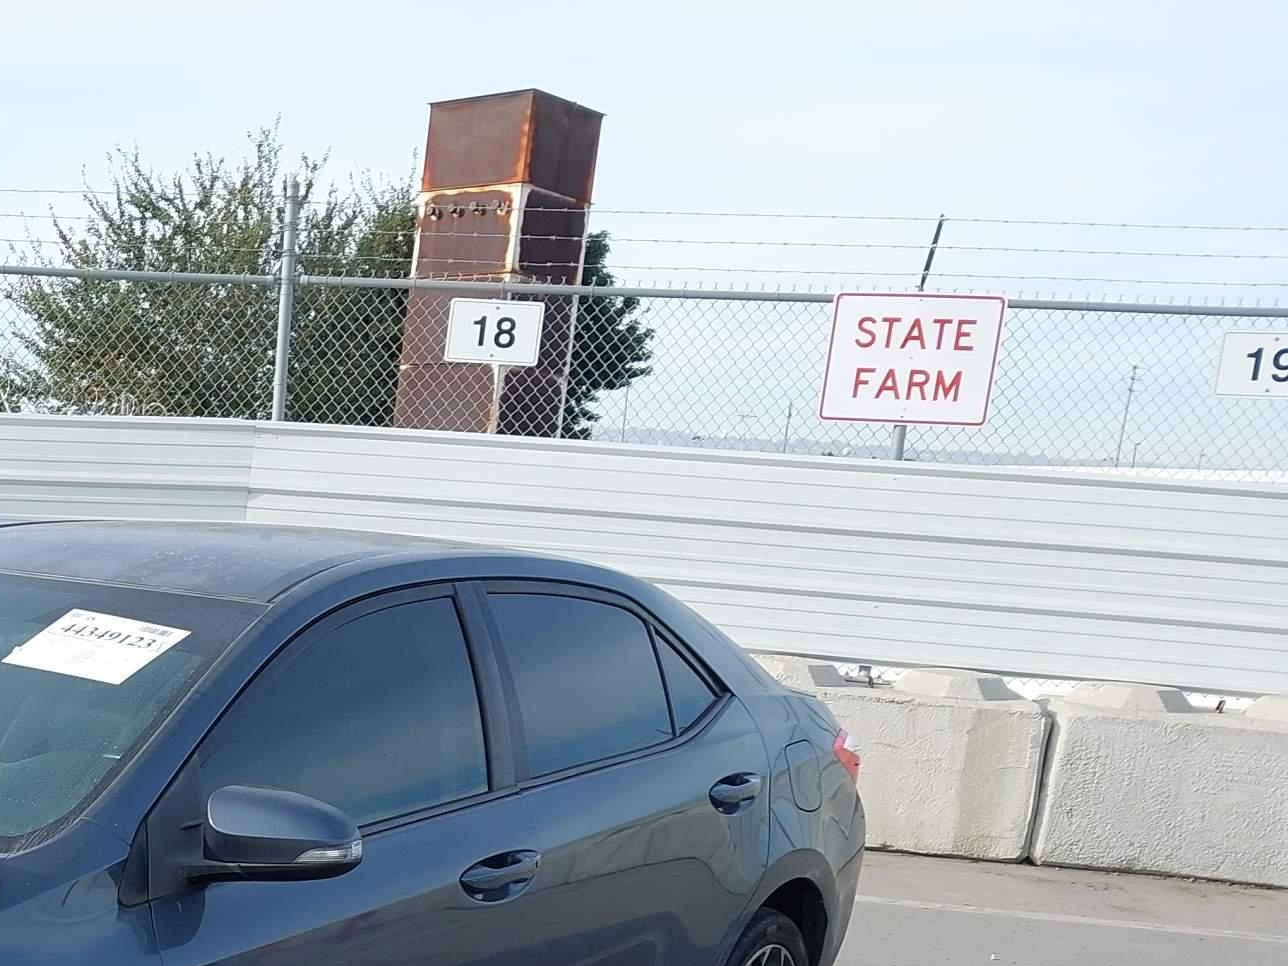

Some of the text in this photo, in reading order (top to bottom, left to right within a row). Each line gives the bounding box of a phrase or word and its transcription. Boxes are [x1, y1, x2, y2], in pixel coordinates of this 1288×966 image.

[473, 315, 517, 349] 18
[856, 316, 977, 352] STATE
[1247, 347, 1288, 383] 19
[853, 367, 963, 400] FARM
[61, 623, 157, 649] 44349123
